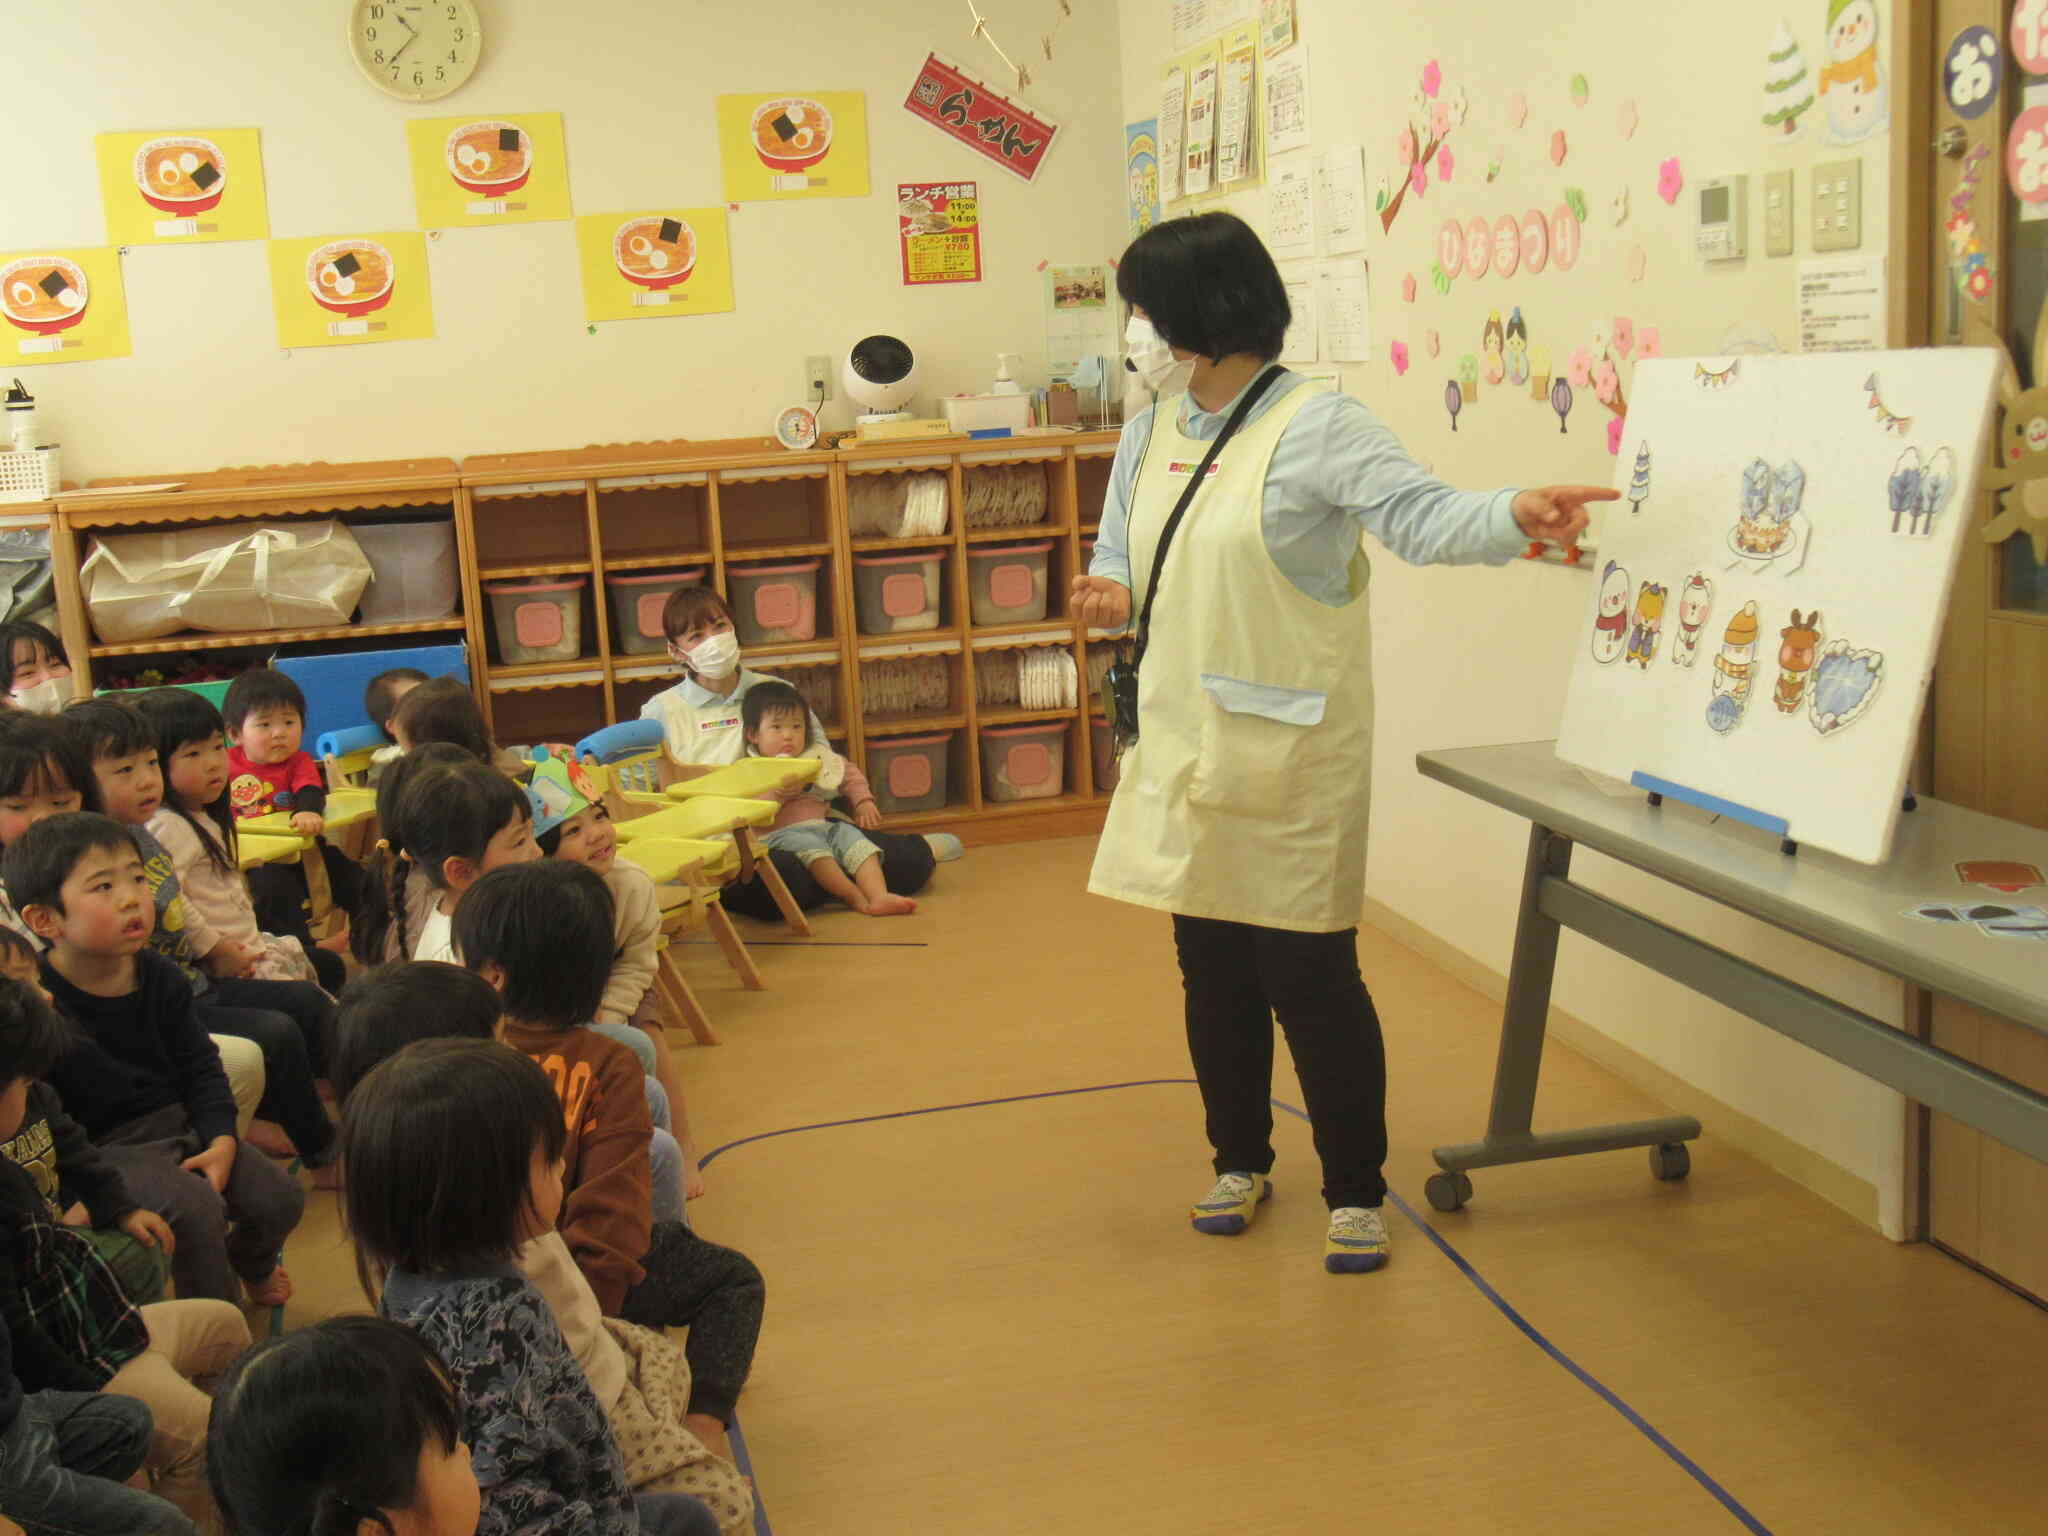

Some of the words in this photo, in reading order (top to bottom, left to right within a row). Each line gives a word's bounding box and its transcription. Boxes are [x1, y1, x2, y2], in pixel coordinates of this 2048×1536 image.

[370, 4, 384, 20] 10
[447, 6, 457, 21] 2
[366, 26, 377, 42] 9
[453, 27, 464, 42] 3
[374, 49, 385, 64] 8
[447, 49, 457, 63] 4
[391, 65, 400, 80] 7
[434, 66, 444, 81] 5
[1951, 33, 1997, 107] お
[413, 71, 424, 86] 6
